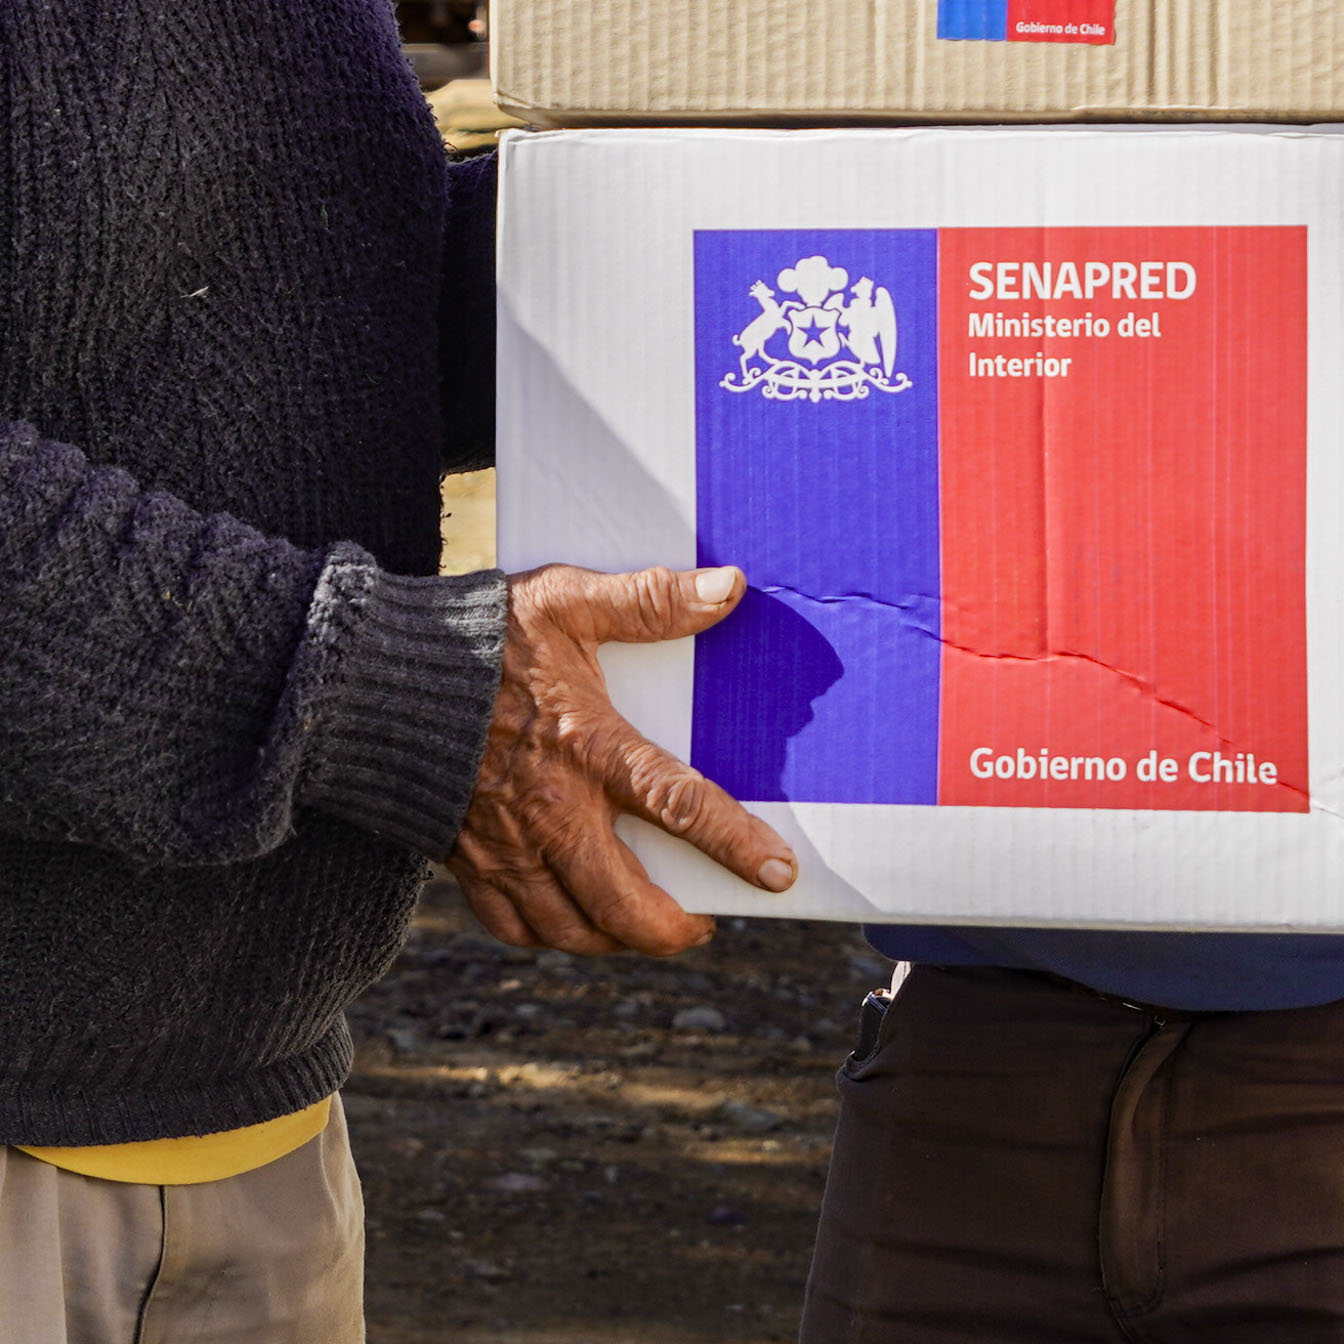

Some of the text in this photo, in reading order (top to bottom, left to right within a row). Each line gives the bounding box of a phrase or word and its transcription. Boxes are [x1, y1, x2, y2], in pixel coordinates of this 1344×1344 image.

[1016, 21, 1105, 35] Gobierno de Chile
[968, 261, 1197, 301] SENAPRED
[968, 312, 1162, 338] Ministerio del
[968, 352, 1073, 377] Interior
[969, 747, 1278, 785] Gobierno de Chile
